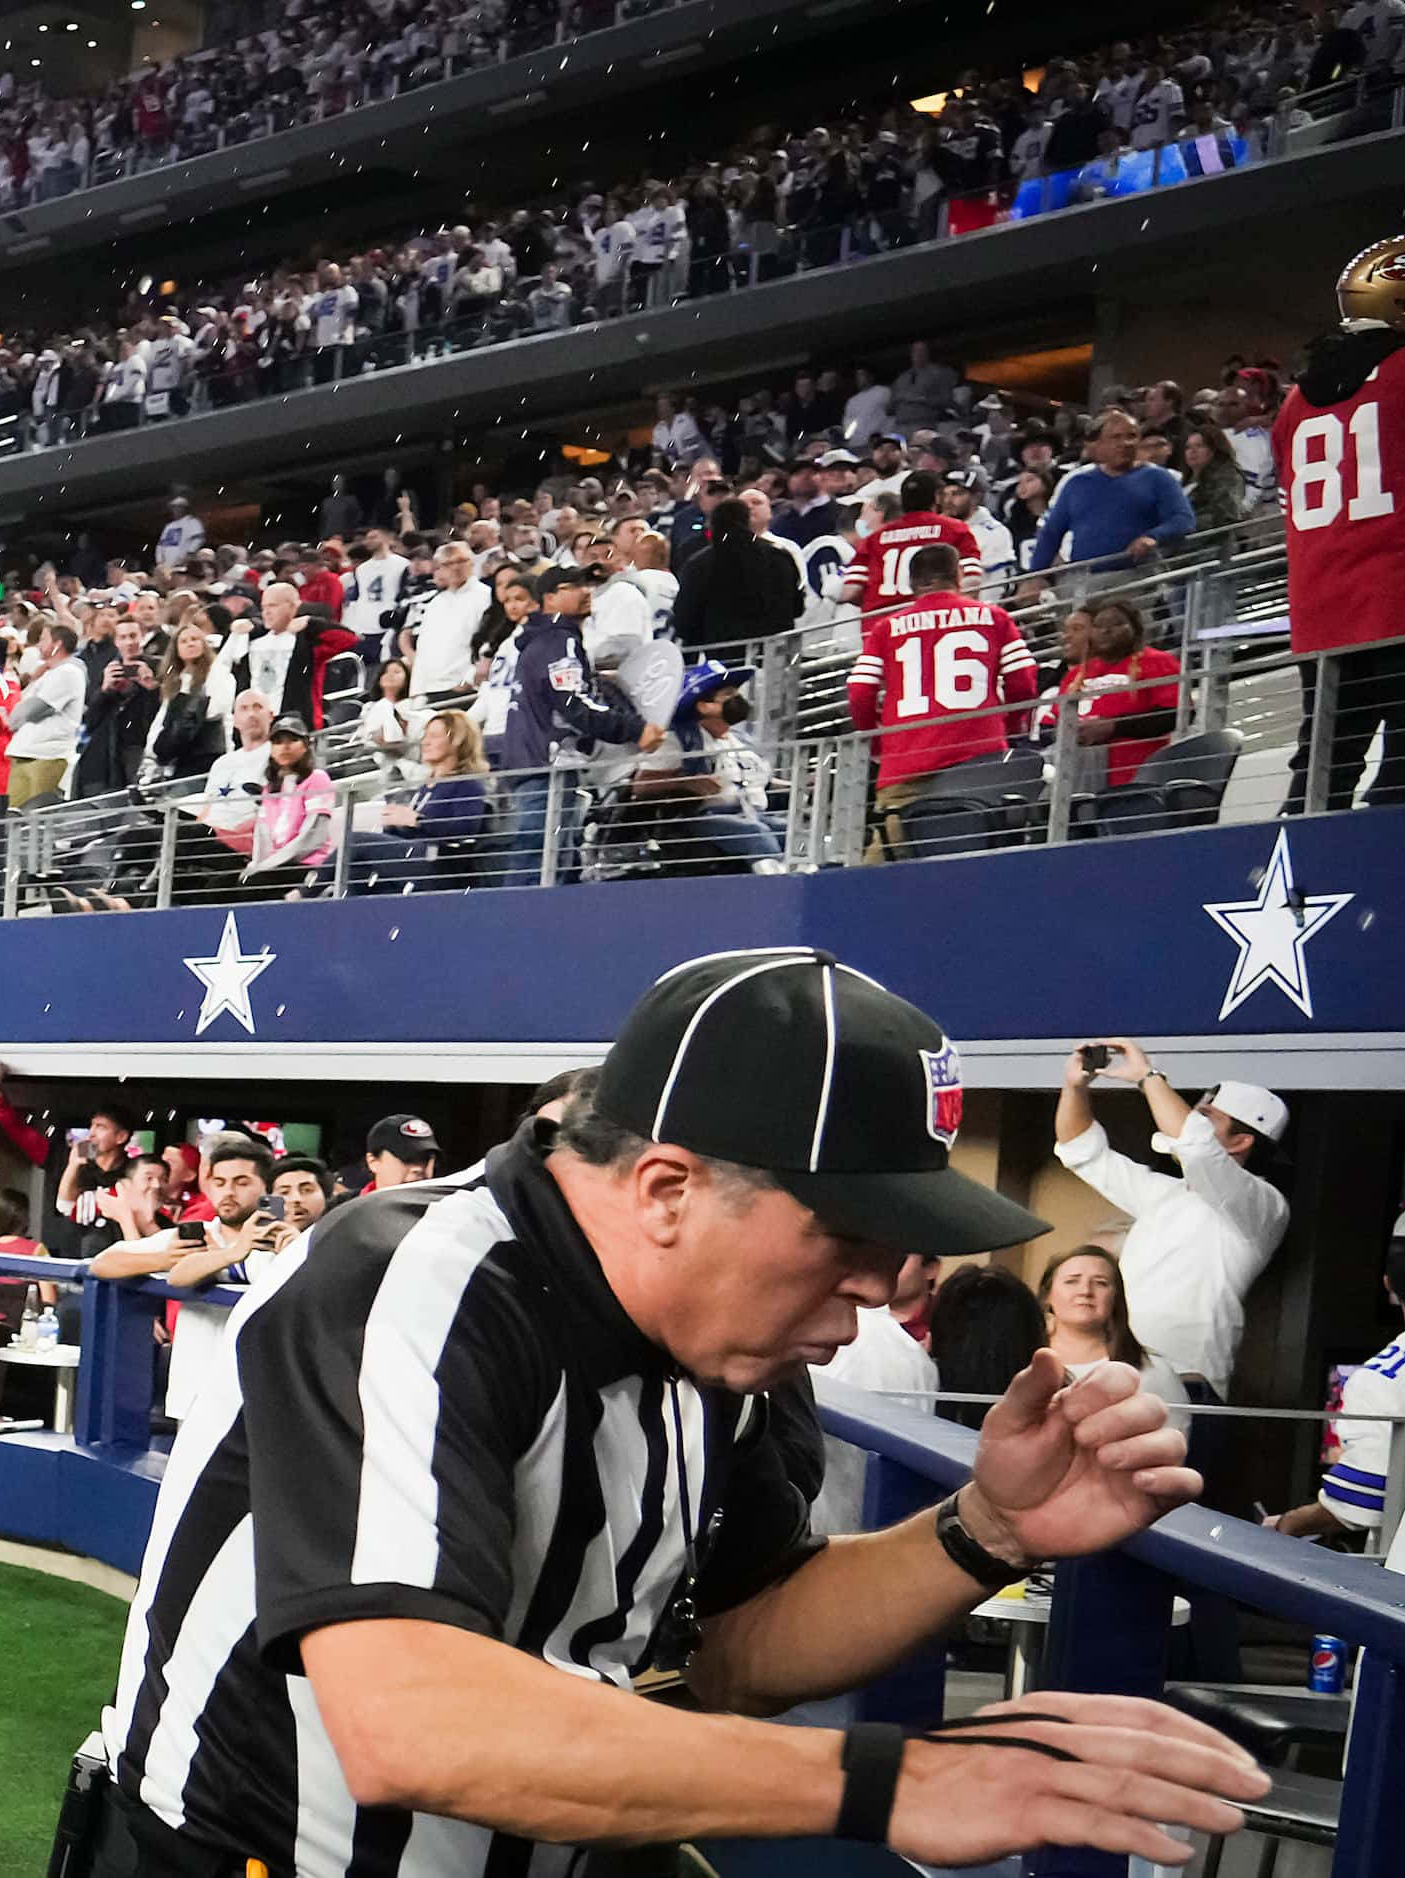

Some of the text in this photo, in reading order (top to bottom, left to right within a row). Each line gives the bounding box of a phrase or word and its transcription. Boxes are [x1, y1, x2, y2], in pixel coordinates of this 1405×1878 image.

[1290, 402, 1395, 531] 81
[367, 575, 383, 603] 4
[889, 606, 994, 637] MONTANA
[896, 630, 989, 718] 16
